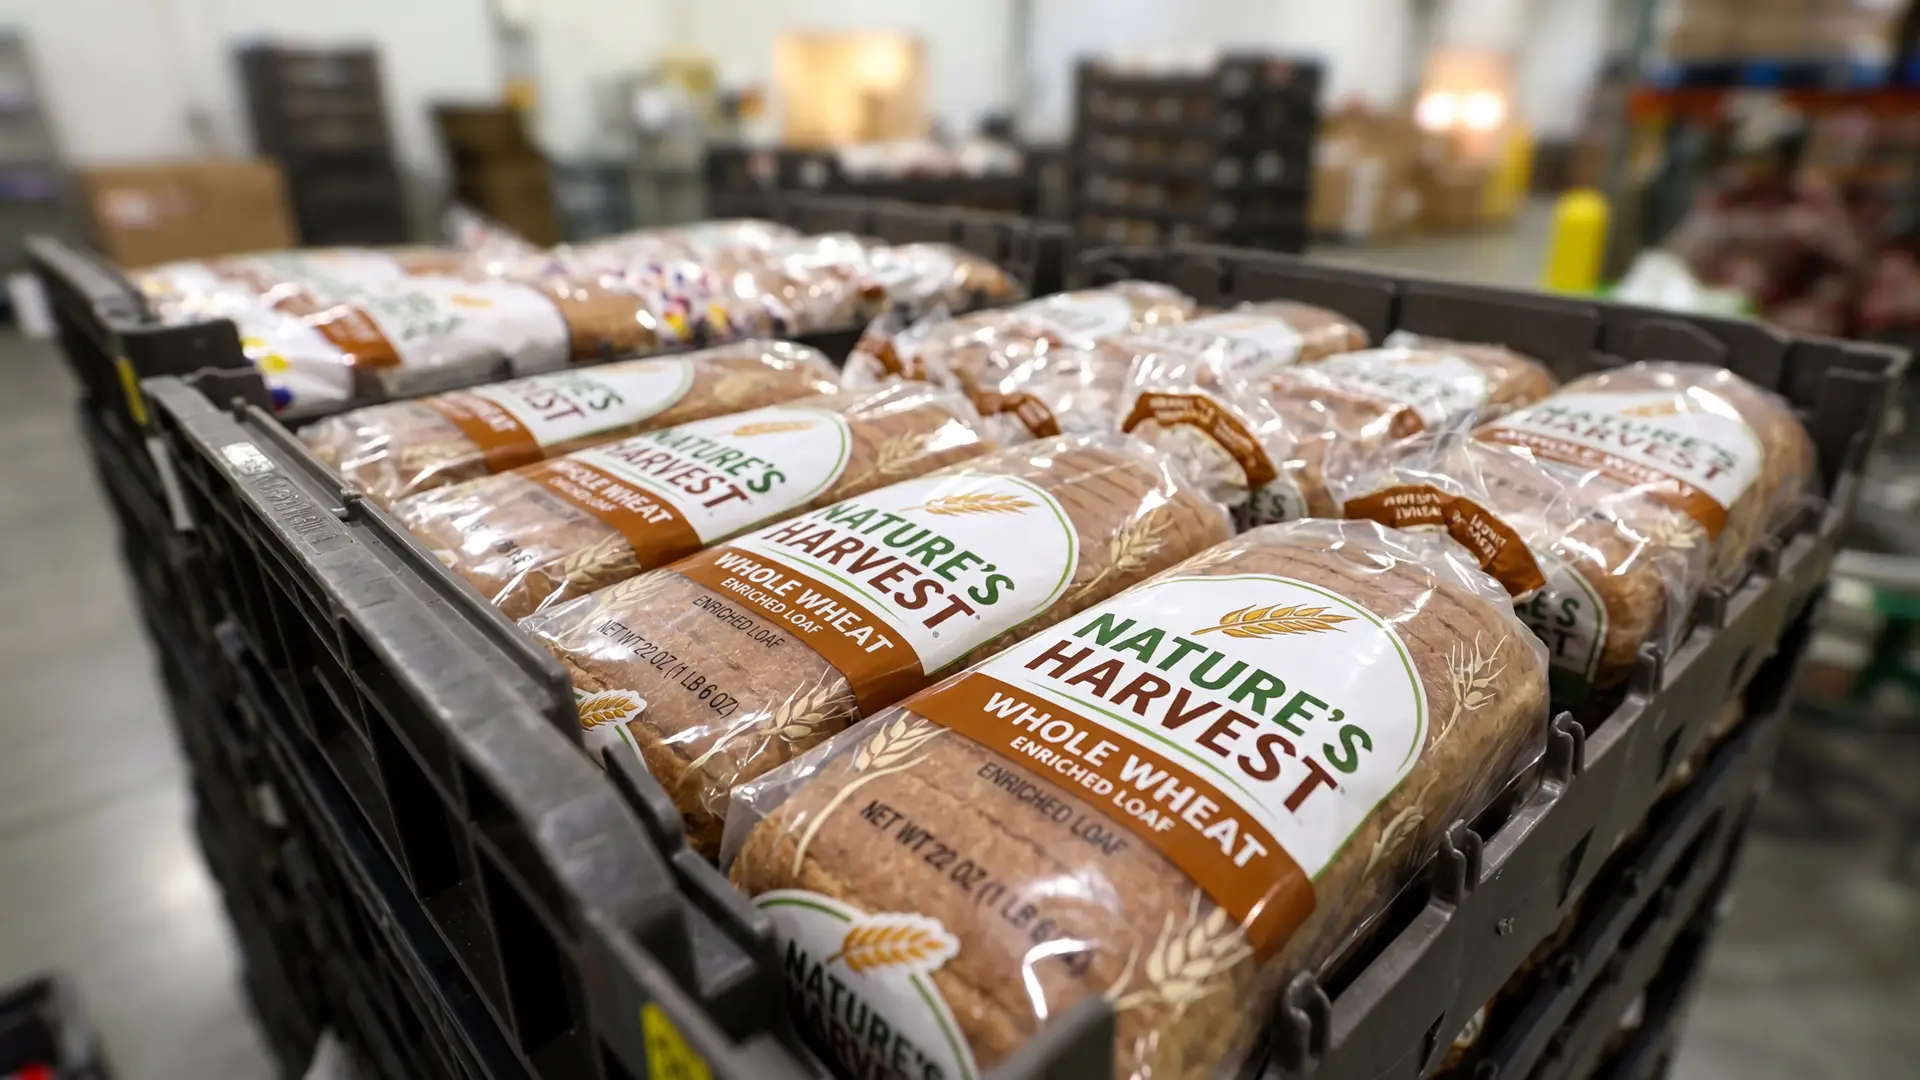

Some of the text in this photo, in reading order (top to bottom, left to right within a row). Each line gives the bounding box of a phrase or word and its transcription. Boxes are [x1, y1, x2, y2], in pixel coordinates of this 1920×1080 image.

[600, 483, 673, 524] WHEAT
[714, 552, 894, 653] WHOLE WHEAT
[761, 521, 976, 630] HARVEST
[811, 503, 1015, 606] NATURE'S
[692, 595, 785, 648] ENRICHED LOAF
[720, 577, 823, 634] ENRICHED LOAF
[597, 619, 741, 719] NET WT 22 OZ (1 LB 6 OZ)
[1074, 612, 1372, 773] NATURE'S
[1024, 640, 1337, 814] HARVEST
[977, 761, 1129, 854] ENRICHED LOAF
[982, 692, 1268, 868] WHOLE WHEAT
[1009, 735, 1175, 832] ENRICHED LOAF
[860, 799, 904, 831] NET
[896, 820, 935, 852] WT
[924, 843, 958, 871] 22
[950, 859, 988, 893] OZ
[1000, 895, 1038, 929] LB
